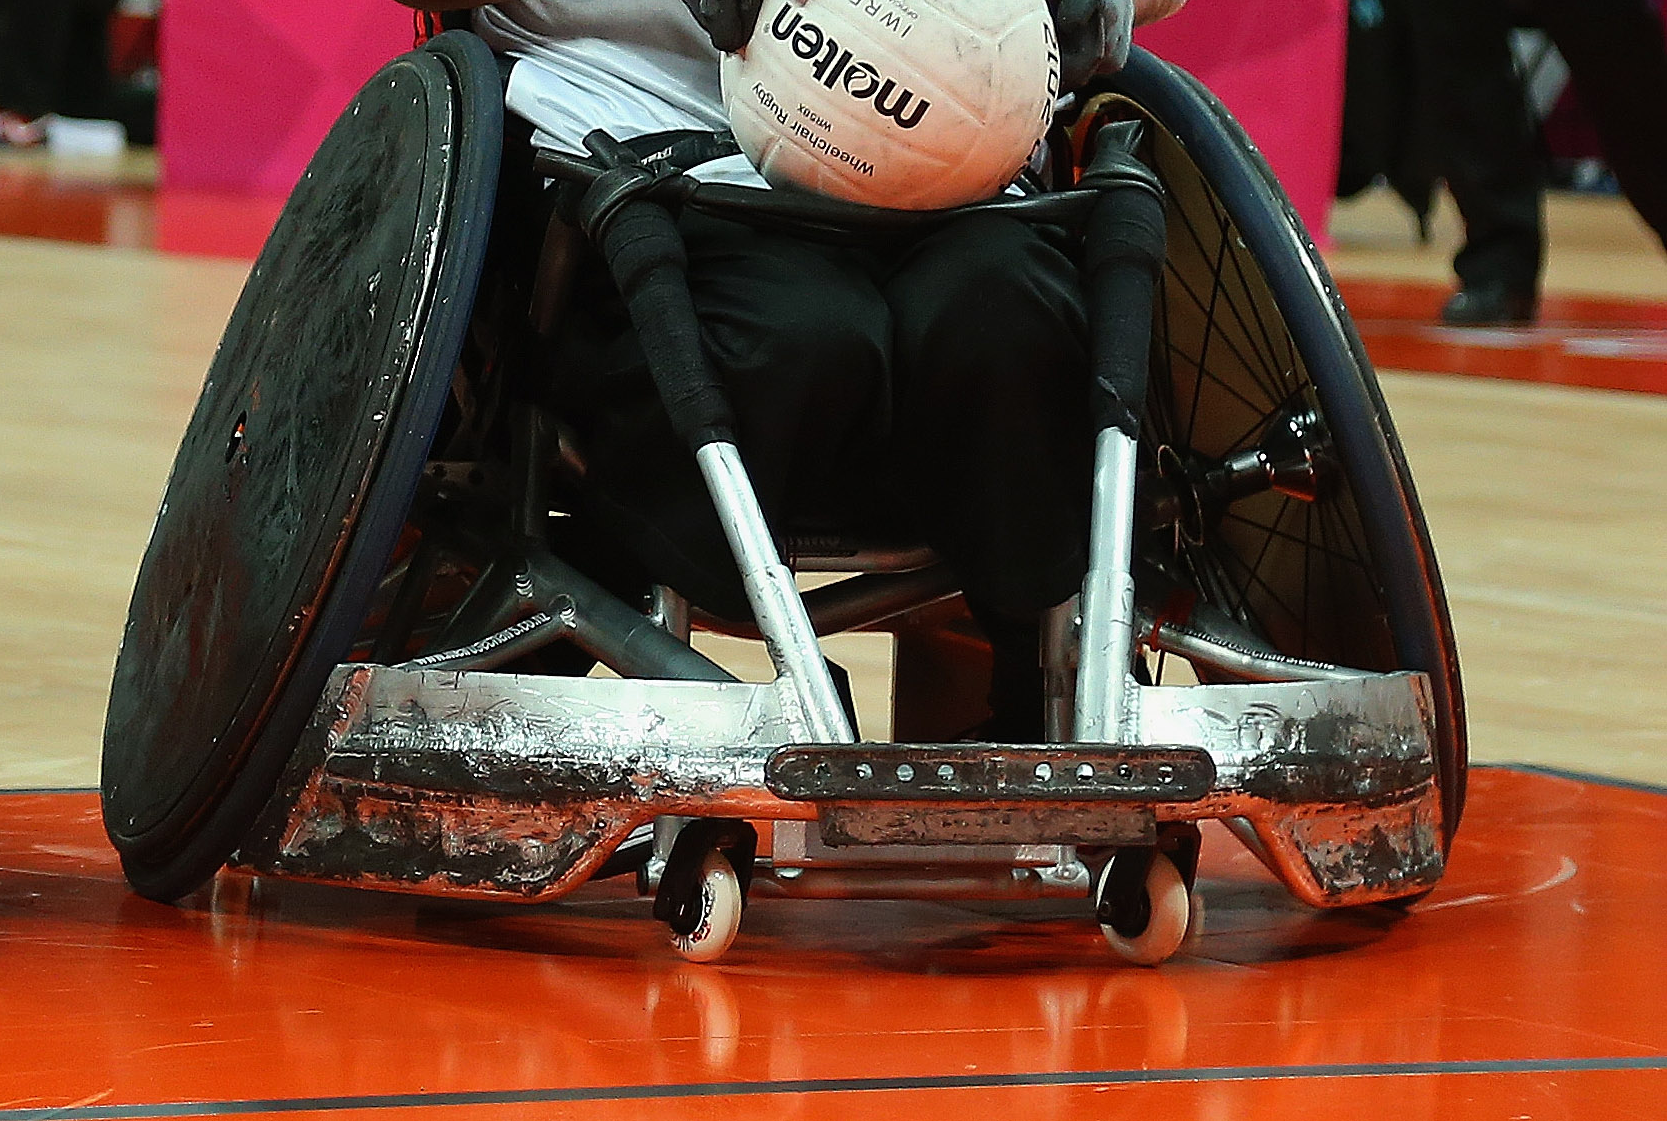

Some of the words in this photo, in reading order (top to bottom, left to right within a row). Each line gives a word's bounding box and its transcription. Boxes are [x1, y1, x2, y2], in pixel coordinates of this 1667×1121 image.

[753, 82, 788, 125] Rugby
[771, 2, 931, 129] molten
[1040, 21, 1060, 126] 2012
[789, 121, 874, 177] Wheelchair
